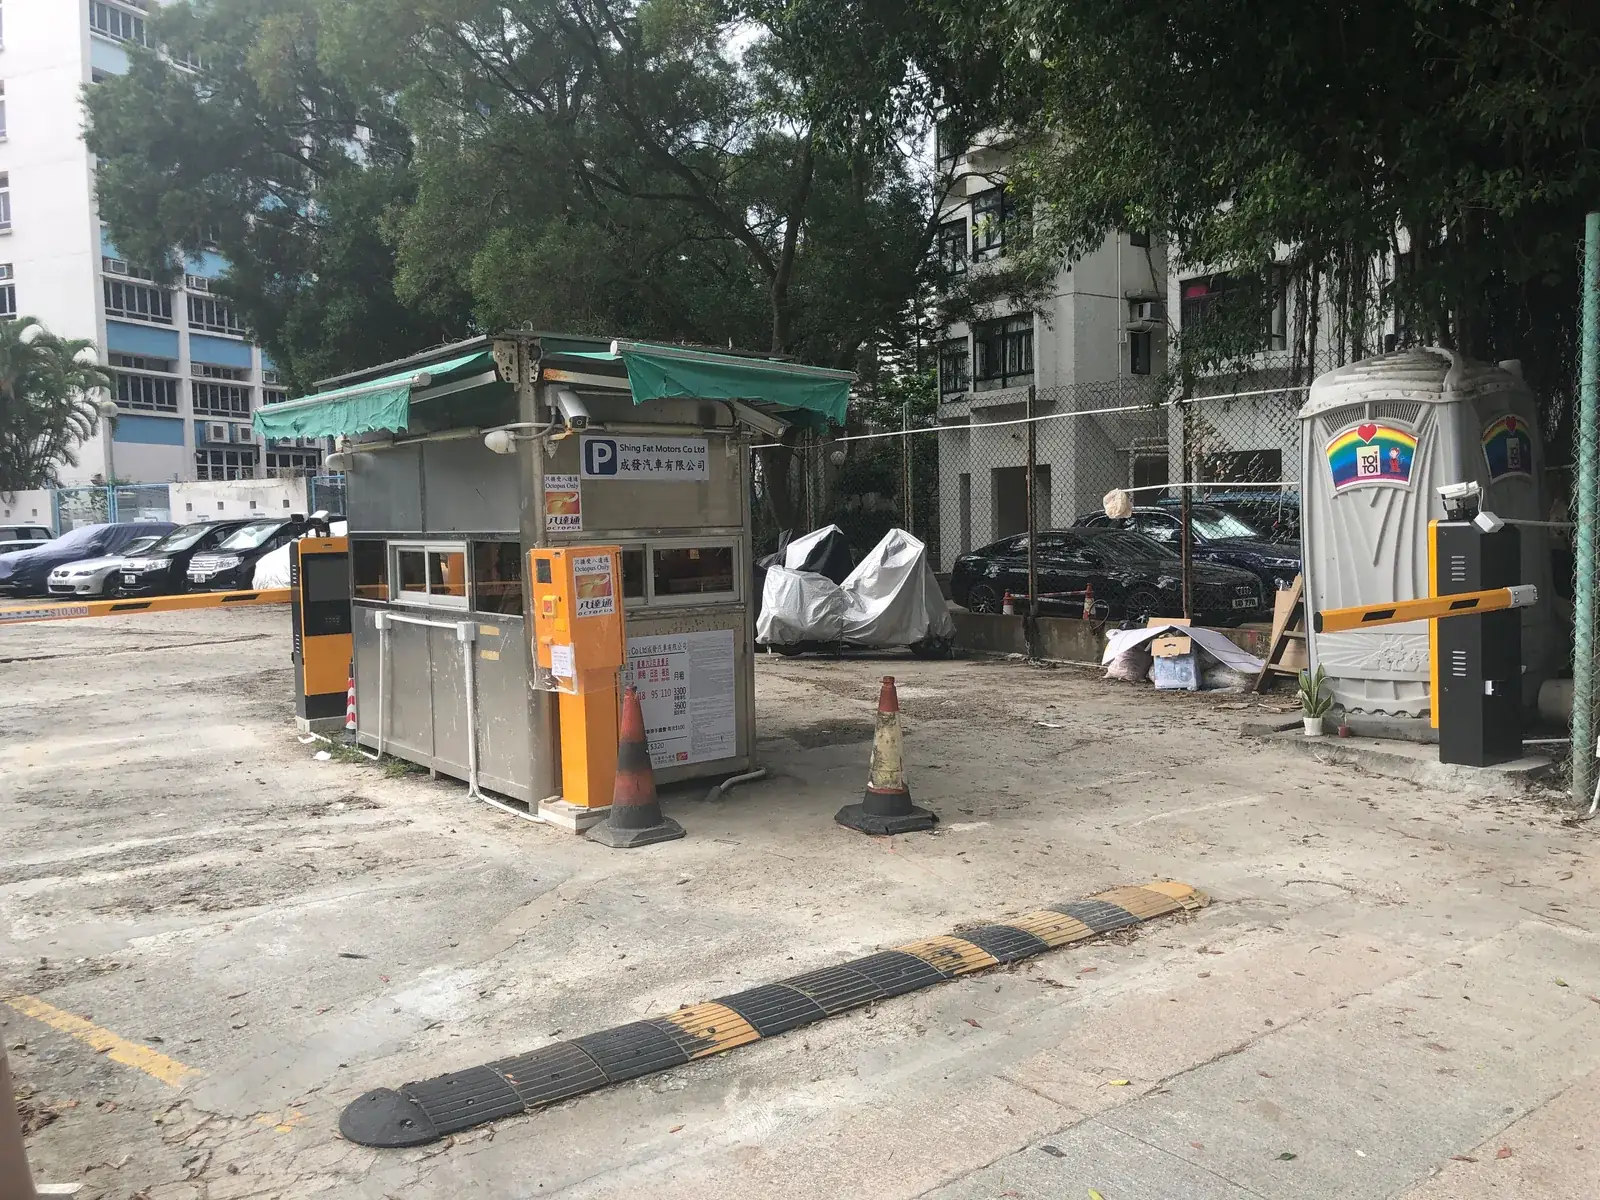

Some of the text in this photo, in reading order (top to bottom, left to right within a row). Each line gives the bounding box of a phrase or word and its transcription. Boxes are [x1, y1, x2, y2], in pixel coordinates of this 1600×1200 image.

[620, 444, 705, 454] Shing Fat Motors Co Ltd
[592, 442, 613, 474] P
[620, 459, 705, 472] 成發汽車有限公司
[548, 516, 580, 526] 八達通
[579, 598, 613, 610] 八達通
[50, 606, 88, 617] $10,000
[577, 608, 613, 616] OCTOPUS
[631, 647, 638, 655] Co
[651, 690, 659, 699] 95
[661, 688, 671, 698] 110
[673, 686, 686, 696] 3300
[673, 701, 686, 710] 3600
[650, 742, 664, 751] $320
